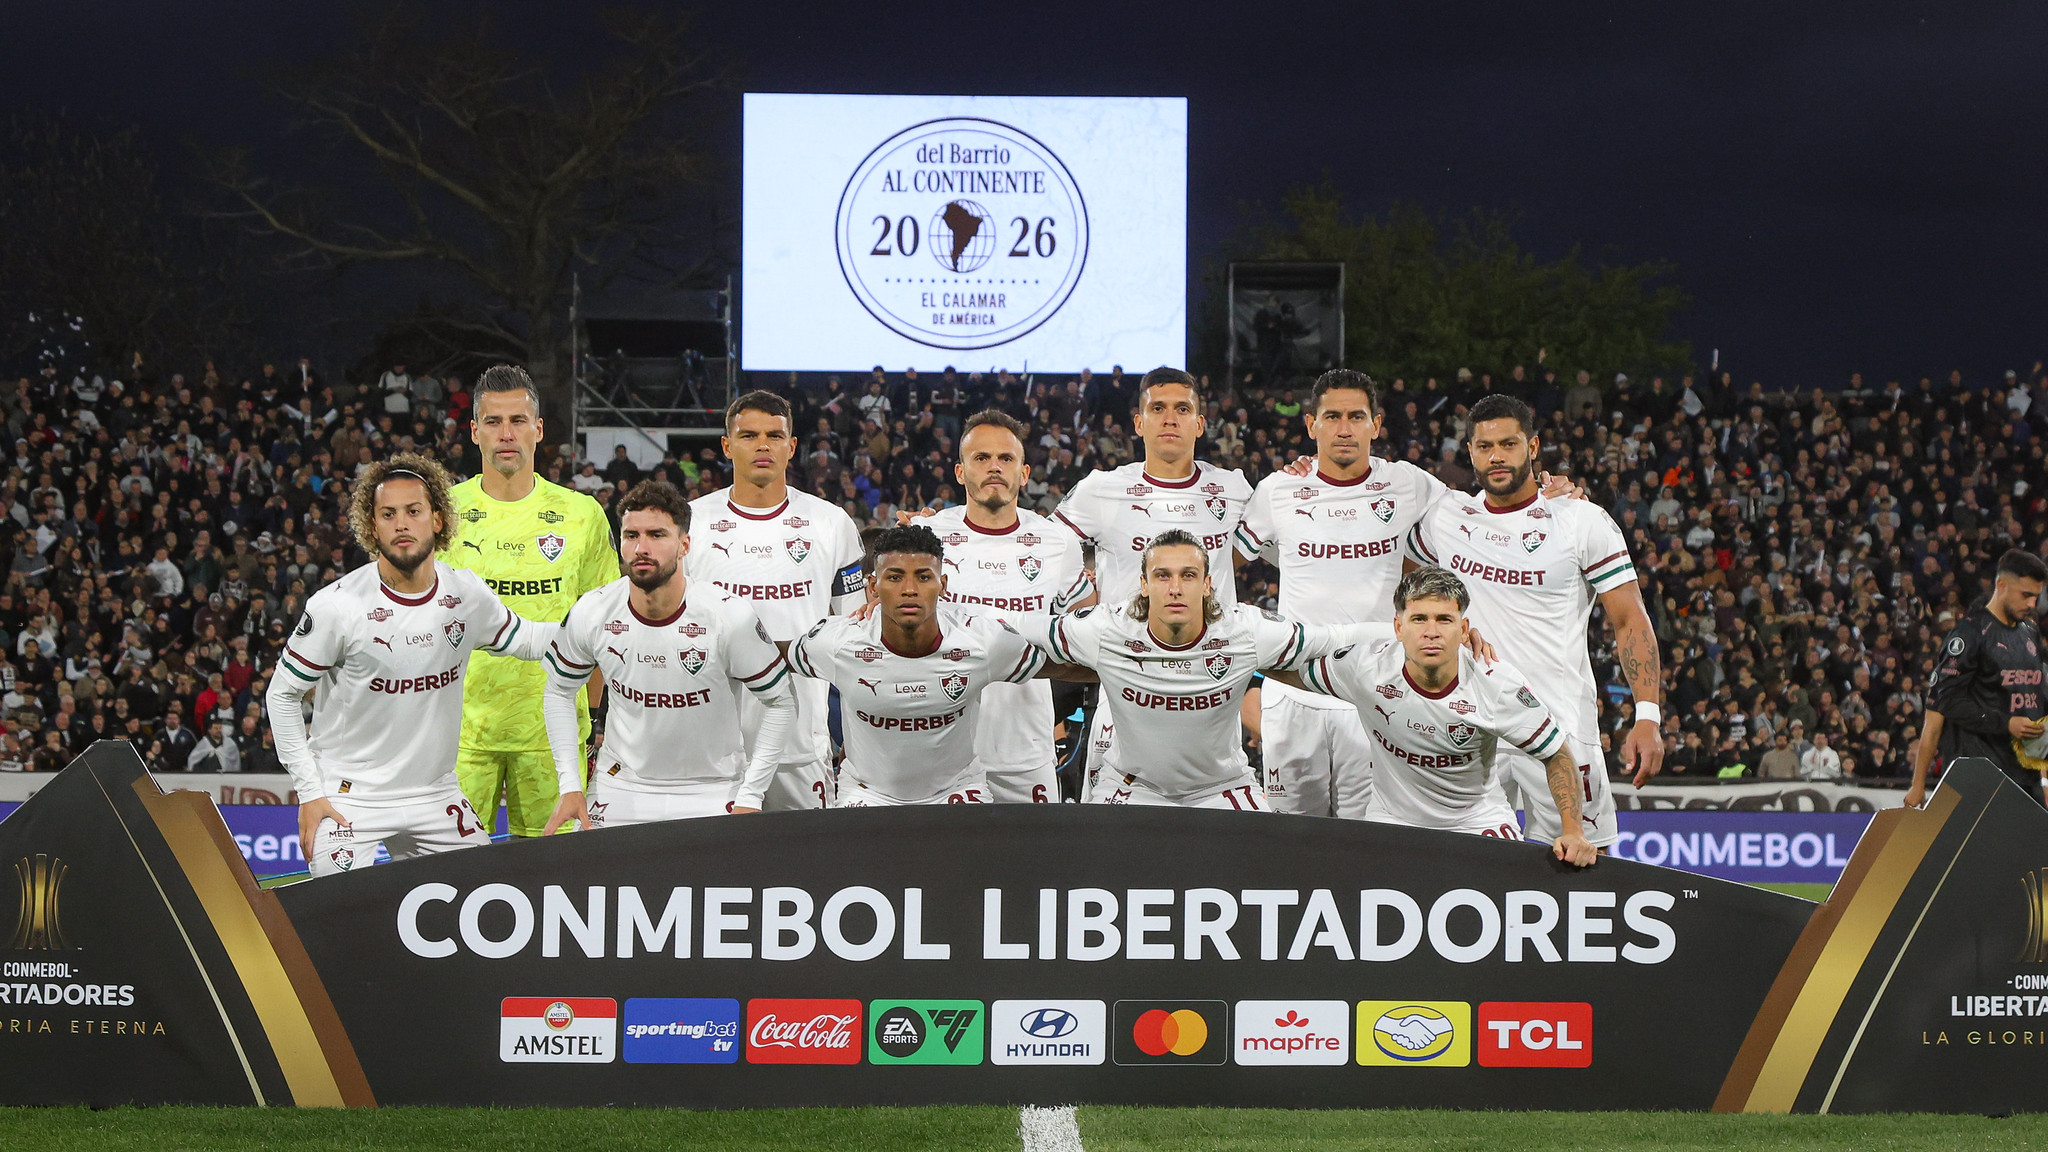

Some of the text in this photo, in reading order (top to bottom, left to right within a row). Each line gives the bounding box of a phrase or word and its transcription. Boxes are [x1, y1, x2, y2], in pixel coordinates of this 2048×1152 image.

[917, 144, 1010, 165] del Barrio
[882, 170, 1046, 194] AL CONTINENTE
[870, 215, 1057, 258] 20 26
[922, 292, 1007, 309] EL CALAMAR
[932, 311, 996, 326] DE AMÉRICA
[1166, 503, 1196, 512] Leve
[1327, 508, 1357, 518] Leve
[496, 540, 526, 551] Leve
[1131, 532, 1229, 551] SBET
[1485, 531, 1511, 542] Leve
[744, 544, 772, 554] Leve
[1297, 535, 1399, 559] SUPERBET
[978, 560, 1007, 570] Leve
[1450, 554, 1546, 586] SUPERBET
[482, 577, 562, 596] PERBET
[406, 632, 433, 646] Leve
[637, 653, 666, 663] Leve
[1161, 658, 1192, 669] Leve
[368, 659, 463, 695] SUPERBET
[611, 678, 711, 709] SUPERBET
[895, 684, 926, 694] Leve
[1121, 687, 1233, 711] SUPERBET
[856, 705, 966, 732] SUPERBET
[1406, 718, 1436, 734] Leve
[1372, 729, 1474, 769] SUPERBET
[1579, 764, 1592, 802] 7
[1610, 832, 1850, 868] CONMEBOL
[396, 882, 951, 962] CONMEBOL
[982, 887, 1678, 965] LIBERTADORES
[0, 1019, 166, 1036] RIA ETERNA
[626, 1021, 737, 1039] sportingbet
[750, 1014, 858, 1049] Coca-Cola
[884, 1018, 918, 1035] EA
[1487, 1019, 1583, 1050] TCL
[513, 1035, 603, 1056] AMSTEL
[883, 1035, 918, 1044] SPORTS
[1243, 1032, 1340, 1054] mapfre
[1922, 1031, 2045, 1045] LA GLORI
[1007, 1044, 1090, 1057] HYUNDAI
